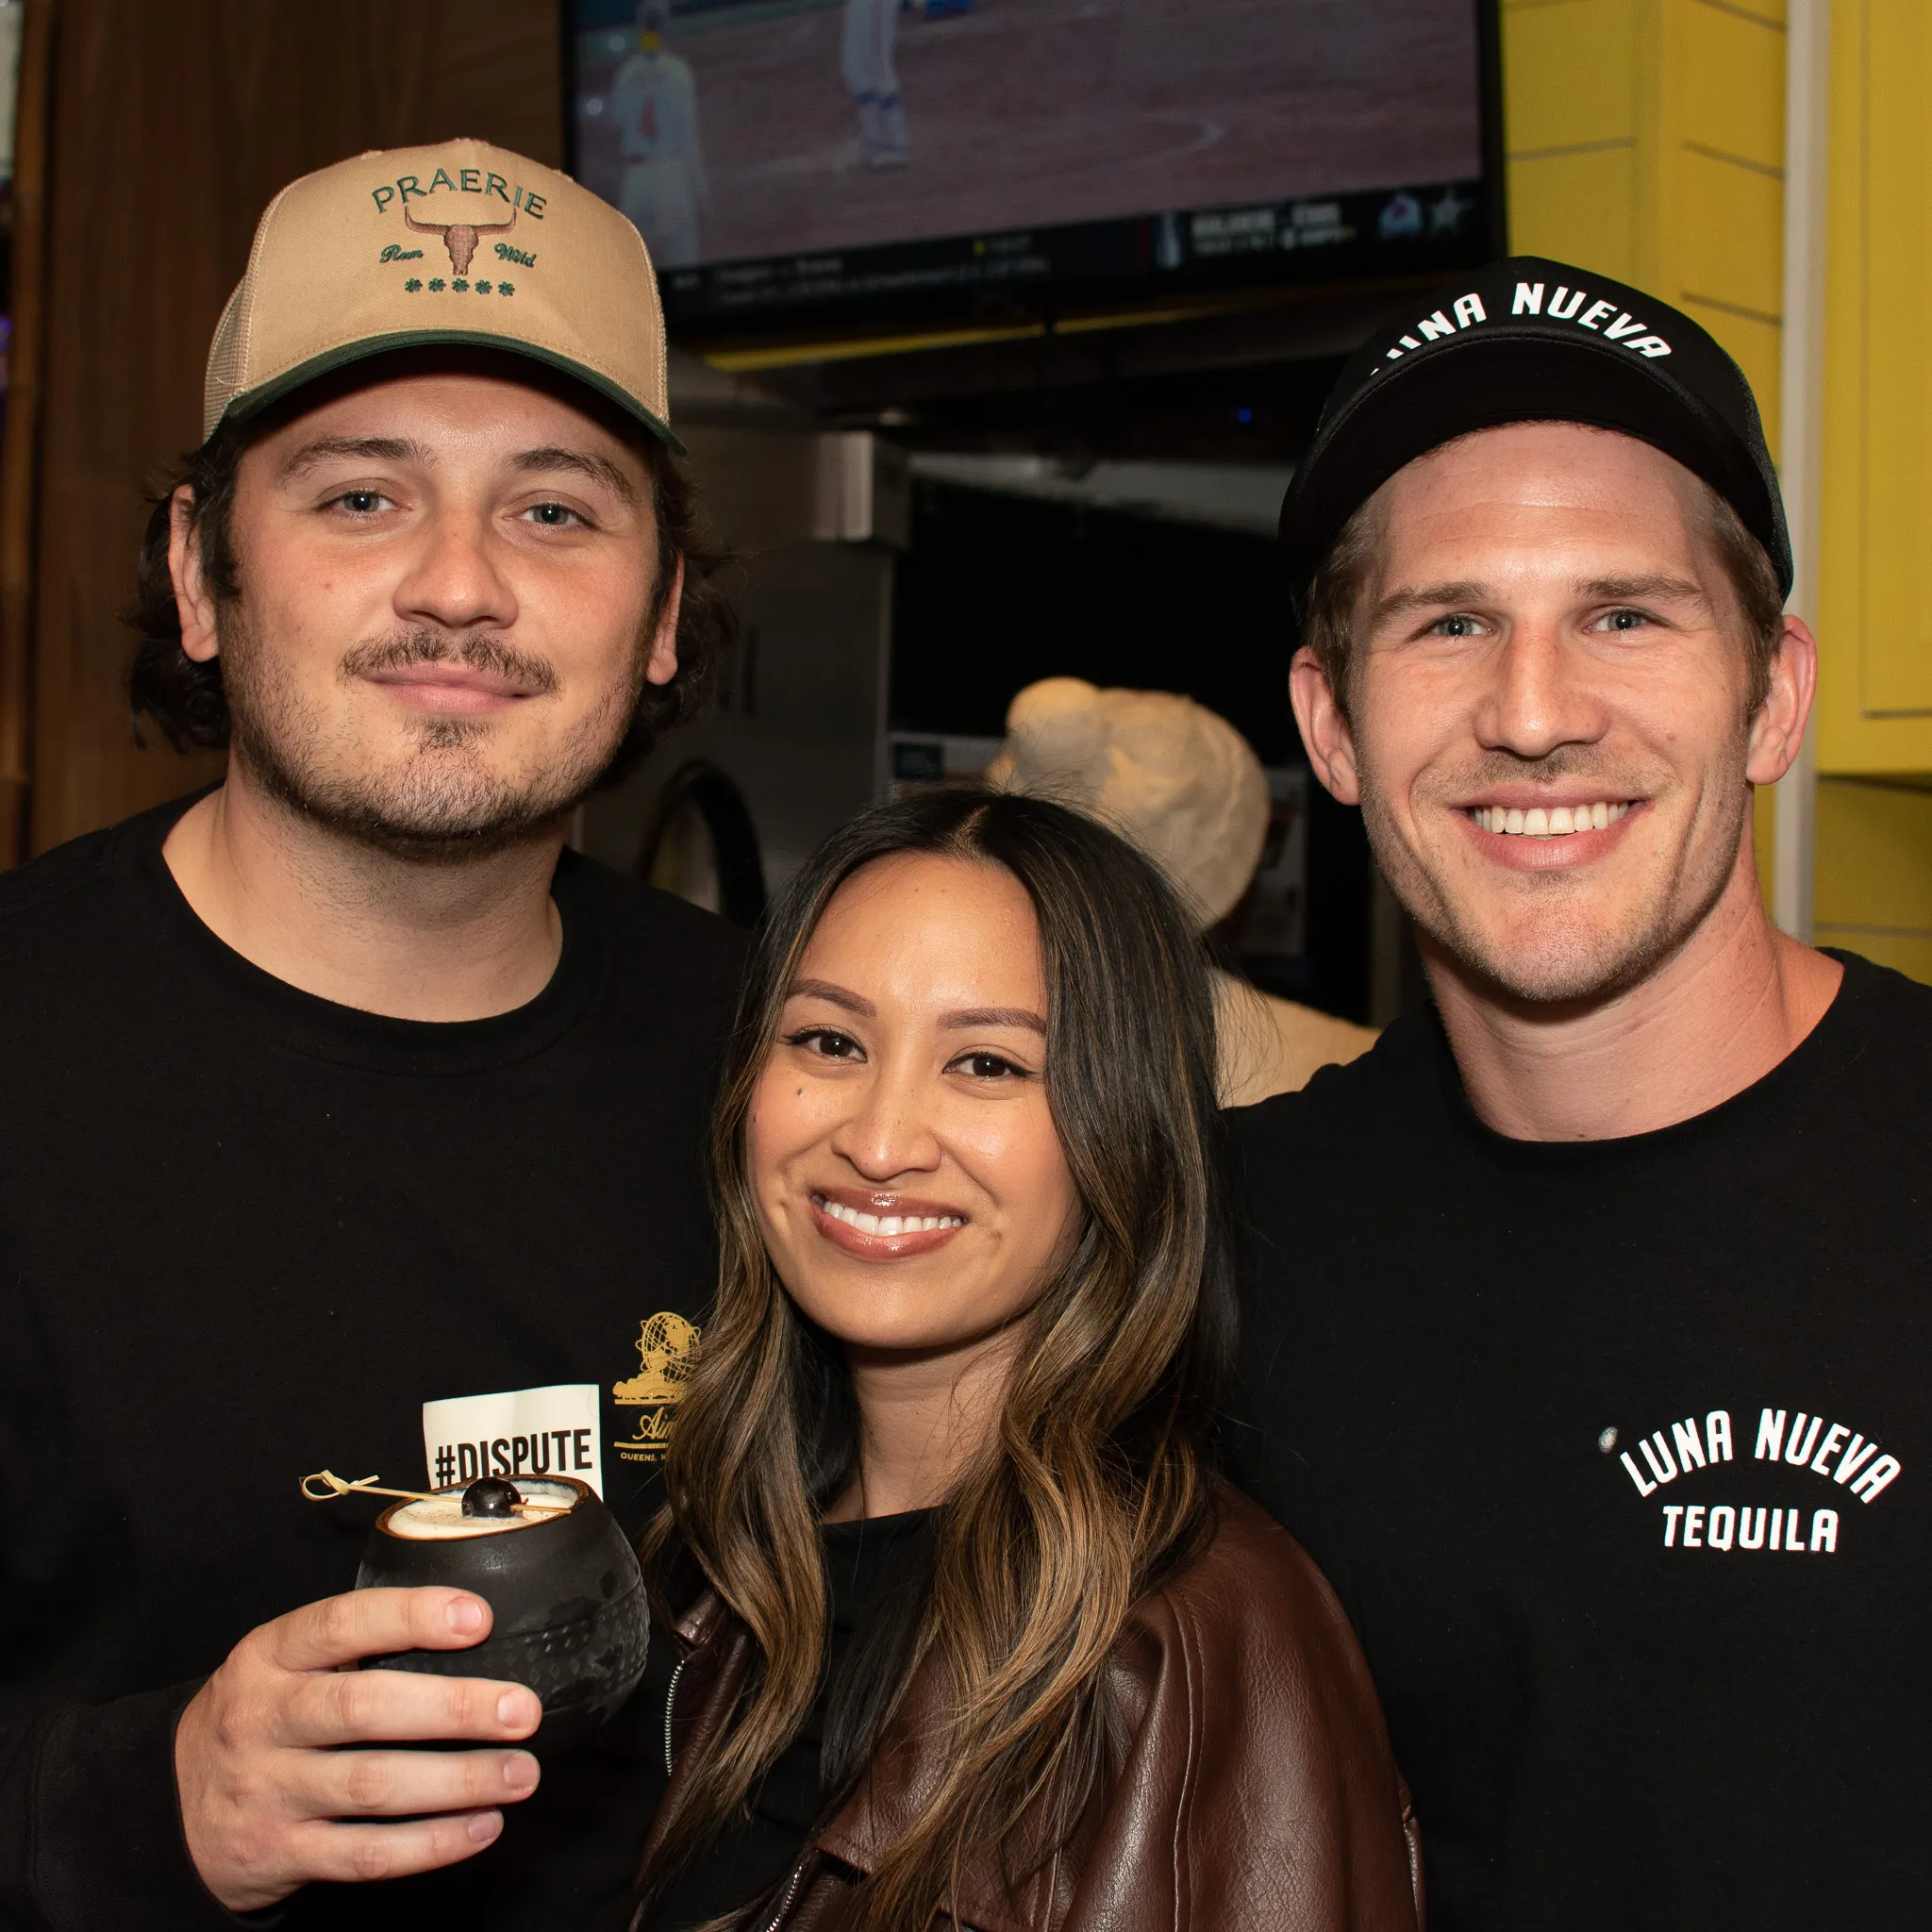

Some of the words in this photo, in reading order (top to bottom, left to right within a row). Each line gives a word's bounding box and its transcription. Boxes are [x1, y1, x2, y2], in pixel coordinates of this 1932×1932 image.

[372, 168, 547, 219] PRAERIE
[493, 242, 537, 268] Wild
[1370, 292, 1487, 376] NA
[1511, 282, 1673, 358] NUEVA
[435, 1428, 593, 1488] #DISPUTE
[620, 1452, 658, 1462] QUEENS,
[1620, 1409, 1733, 1498] LUNA
[1755, 1407, 1902, 1505] NUEVA
[1662, 1505, 1839, 1553] TEQUILA
